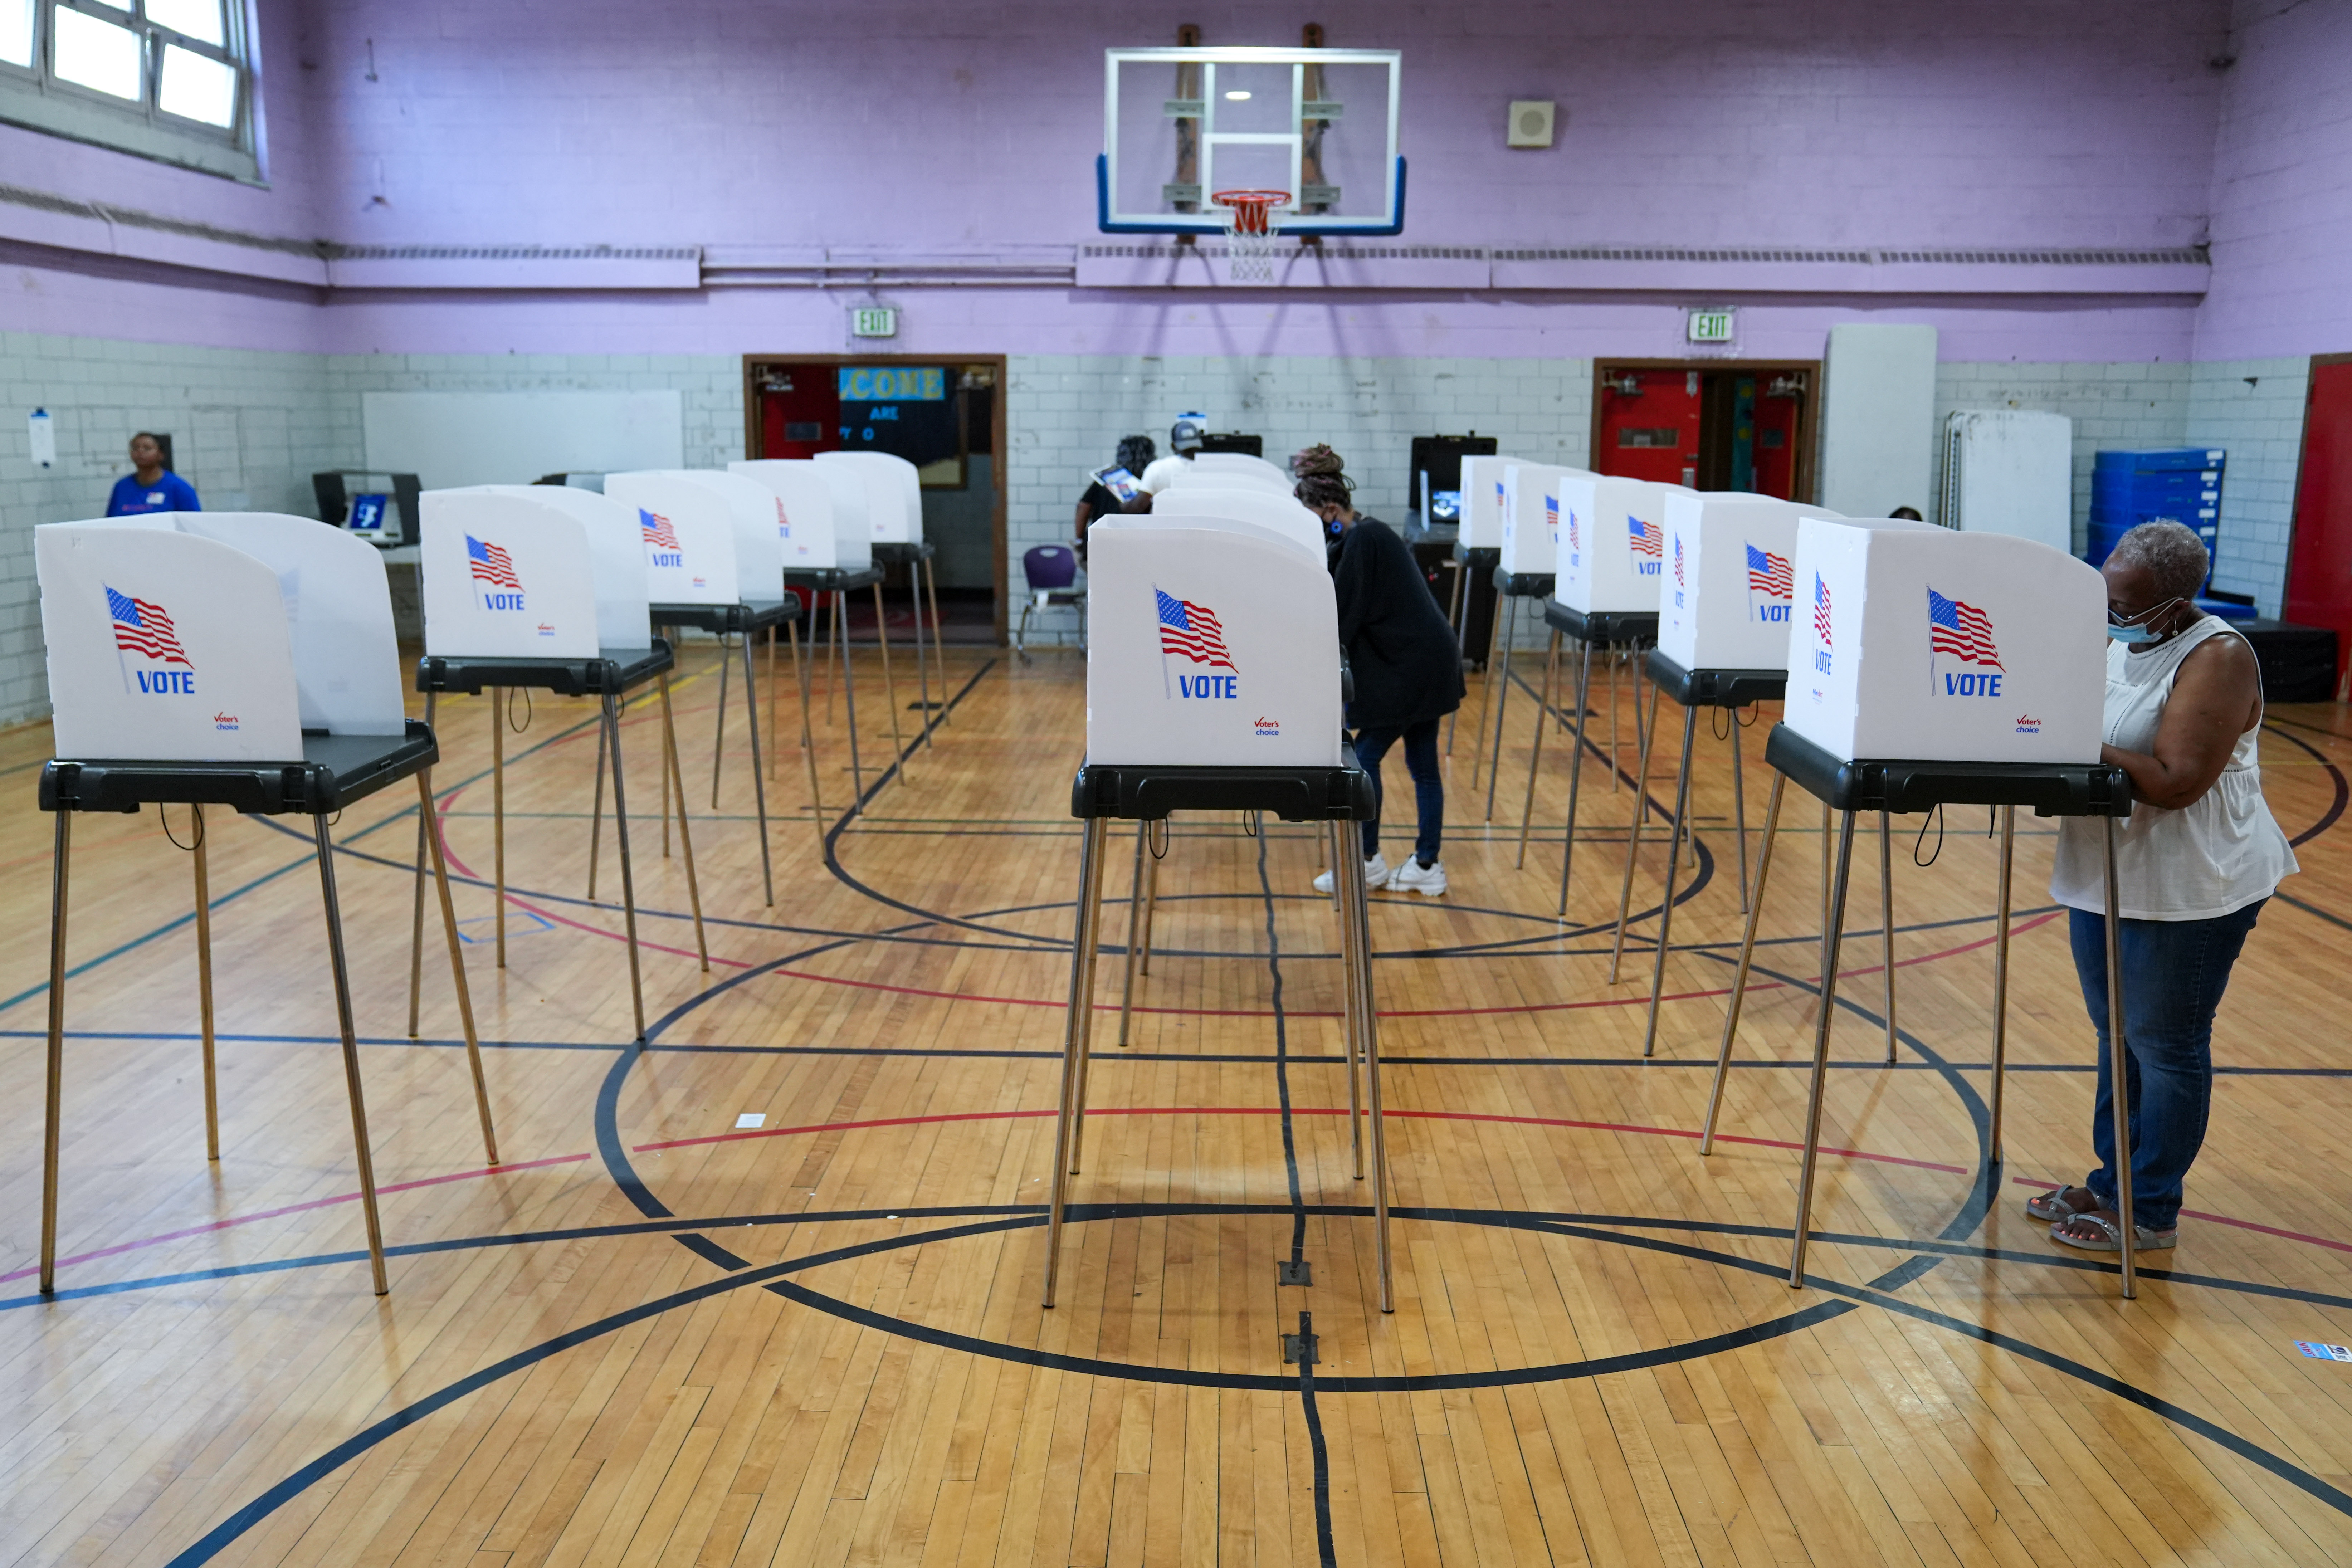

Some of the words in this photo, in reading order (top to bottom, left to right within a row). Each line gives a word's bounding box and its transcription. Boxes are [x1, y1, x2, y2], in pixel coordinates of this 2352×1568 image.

[860, 311, 887, 332] EXIT
[1698, 316, 1728, 337] EXIT
[869, 406, 899, 420] ARE
[653, 554, 682, 567] VOTE
[1639, 562, 1662, 575] VOT
[485, 594, 525, 610] VOTE
[1675, 590, 1684, 609] VOTE
[1760, 605, 1792, 622] VOT
[1816, 649, 1832, 676] VOTE
[137, 671, 195, 694] VOTE
[1180, 675, 1237, 699] VOTE
[1946, 673, 2002, 697] VOTE
[214, 712, 239, 723] Voter's
[1254, 717, 1279, 728] Voter's
[2017, 714, 2041, 725] Voter's
[2297, 1342, 2316, 1357] JAIN
